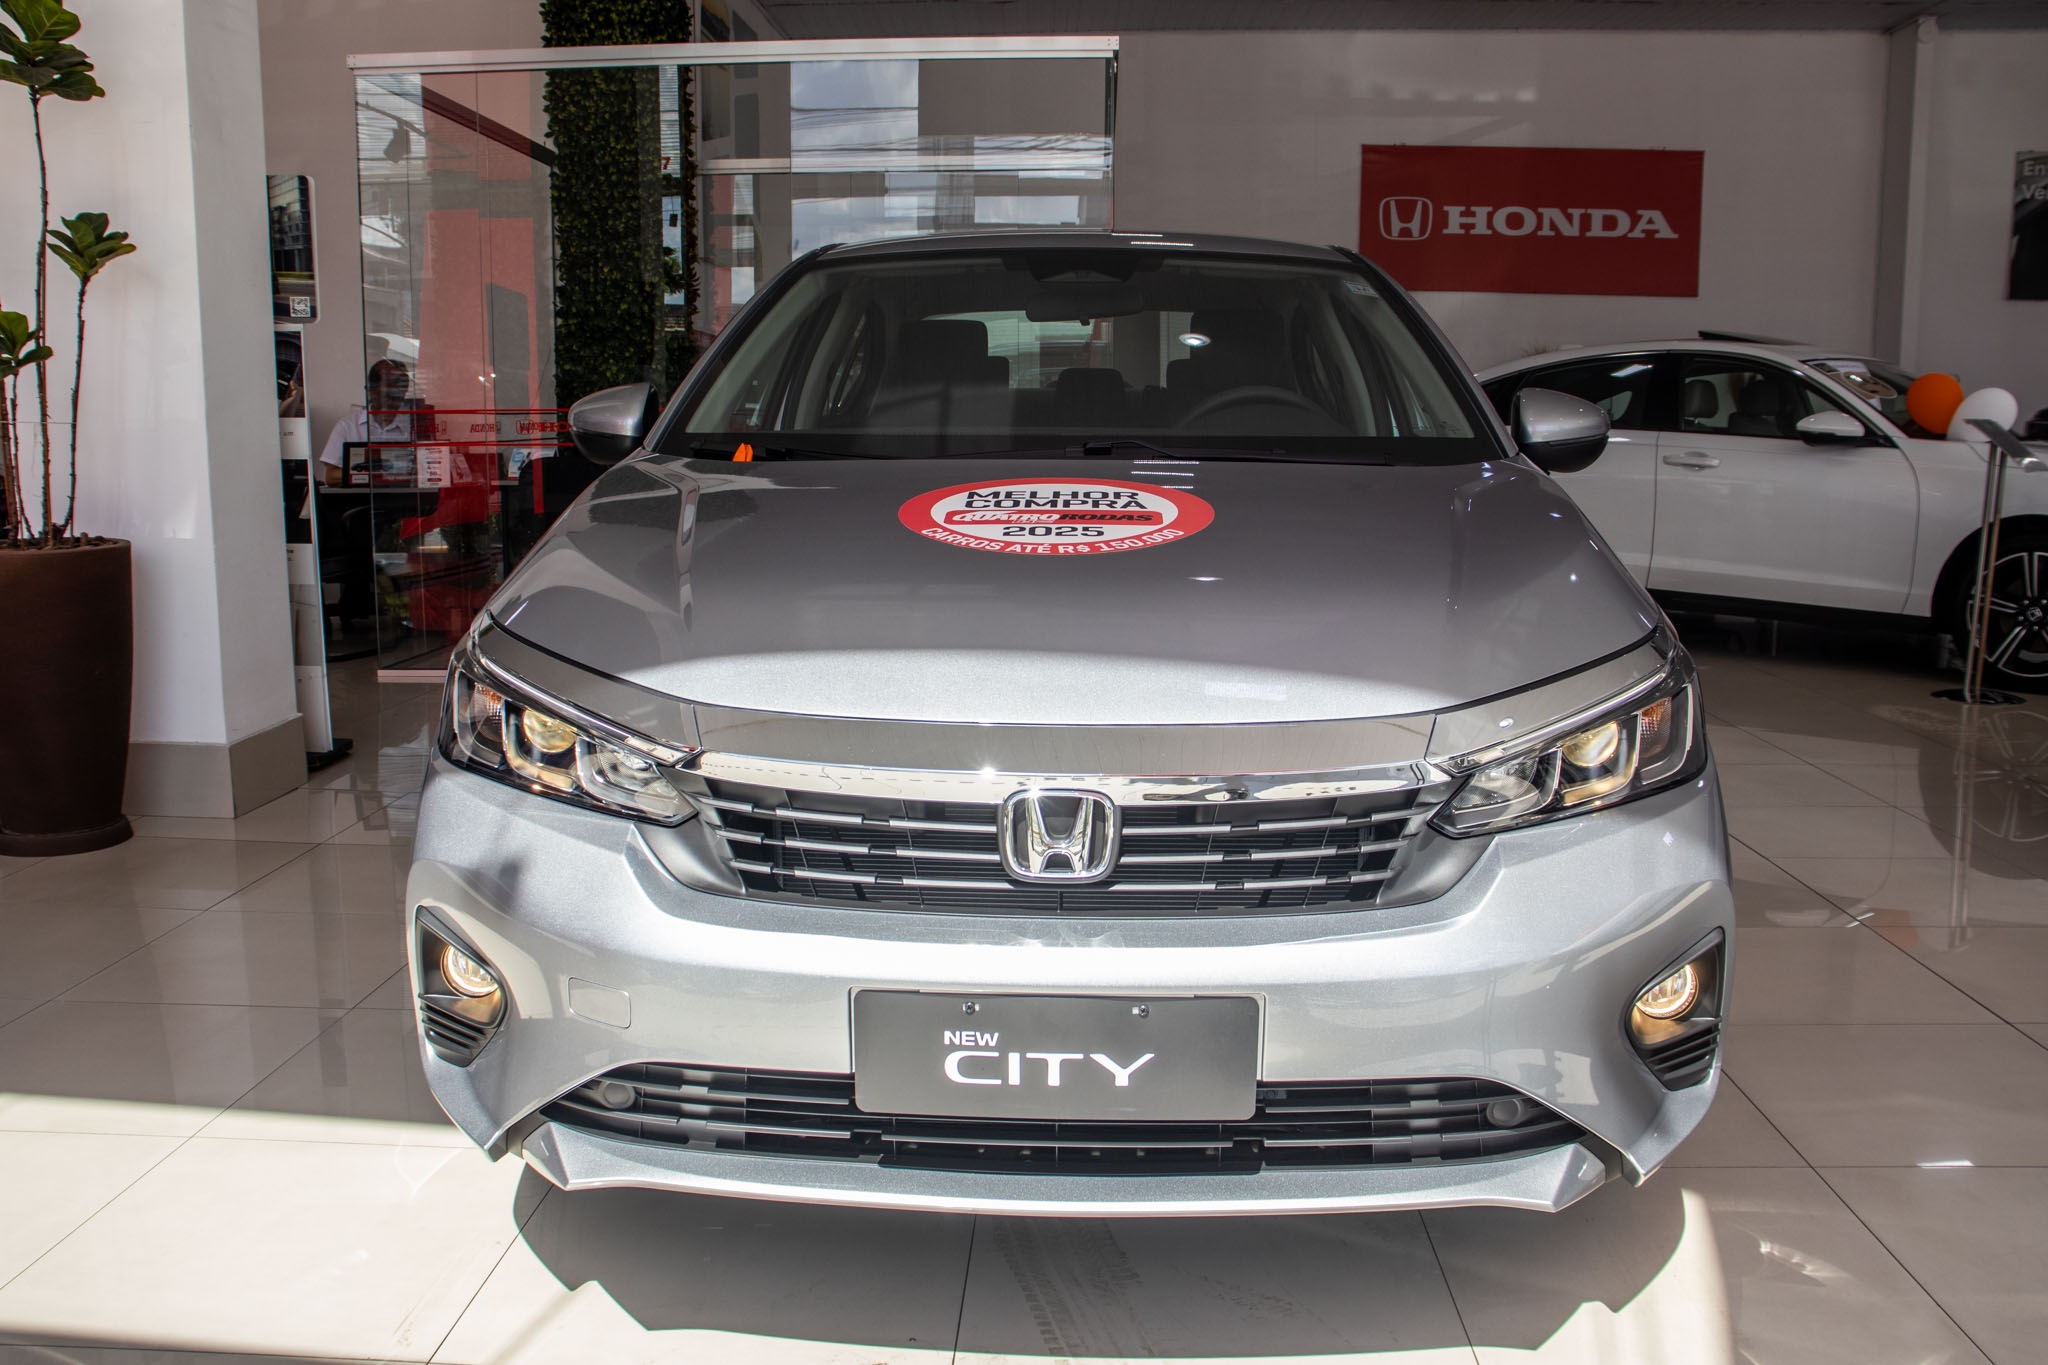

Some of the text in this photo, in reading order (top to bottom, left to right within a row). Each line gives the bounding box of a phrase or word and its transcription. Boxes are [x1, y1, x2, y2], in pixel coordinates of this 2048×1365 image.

[1442, 205, 1679, 238] HONDA
[966, 490, 1139, 500] MELHOR
[965, 499, 1148, 510] COMPRA
[1002, 526, 1104, 537] 2025
[921, 527, 1185, 554] CARROS ATÉ R$ 150.000
[943, 1031, 999, 1047] NEW
[943, 1051, 1155, 1087] CITY
